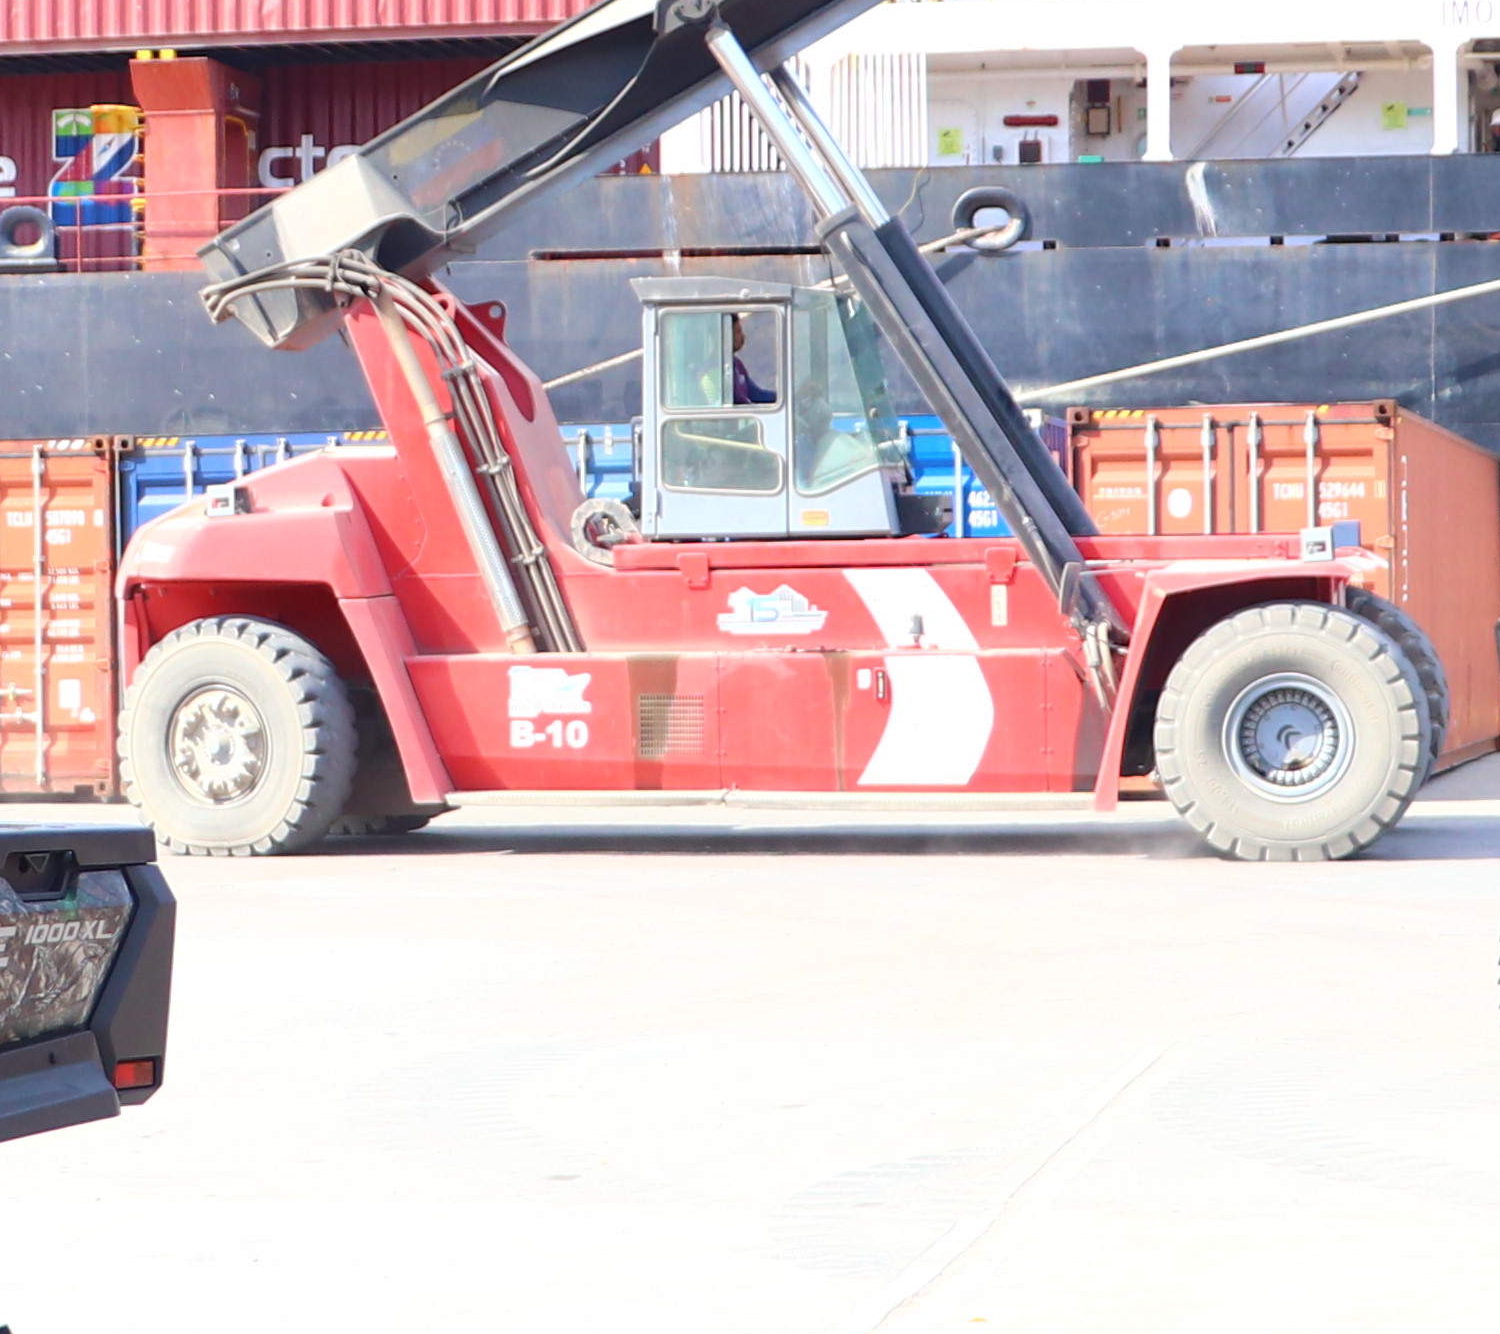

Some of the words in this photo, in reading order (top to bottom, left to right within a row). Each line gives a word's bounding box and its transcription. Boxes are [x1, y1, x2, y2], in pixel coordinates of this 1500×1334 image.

[1272, 482, 1304, 500] TCNU
[1318, 481, 1366, 499] 529644
[1318, 501, 1348, 518] 45G1
[509, 719, 589, 749] B-10
[24, 920, 81, 946] 1000
[81, 919, 113, 940] XL
